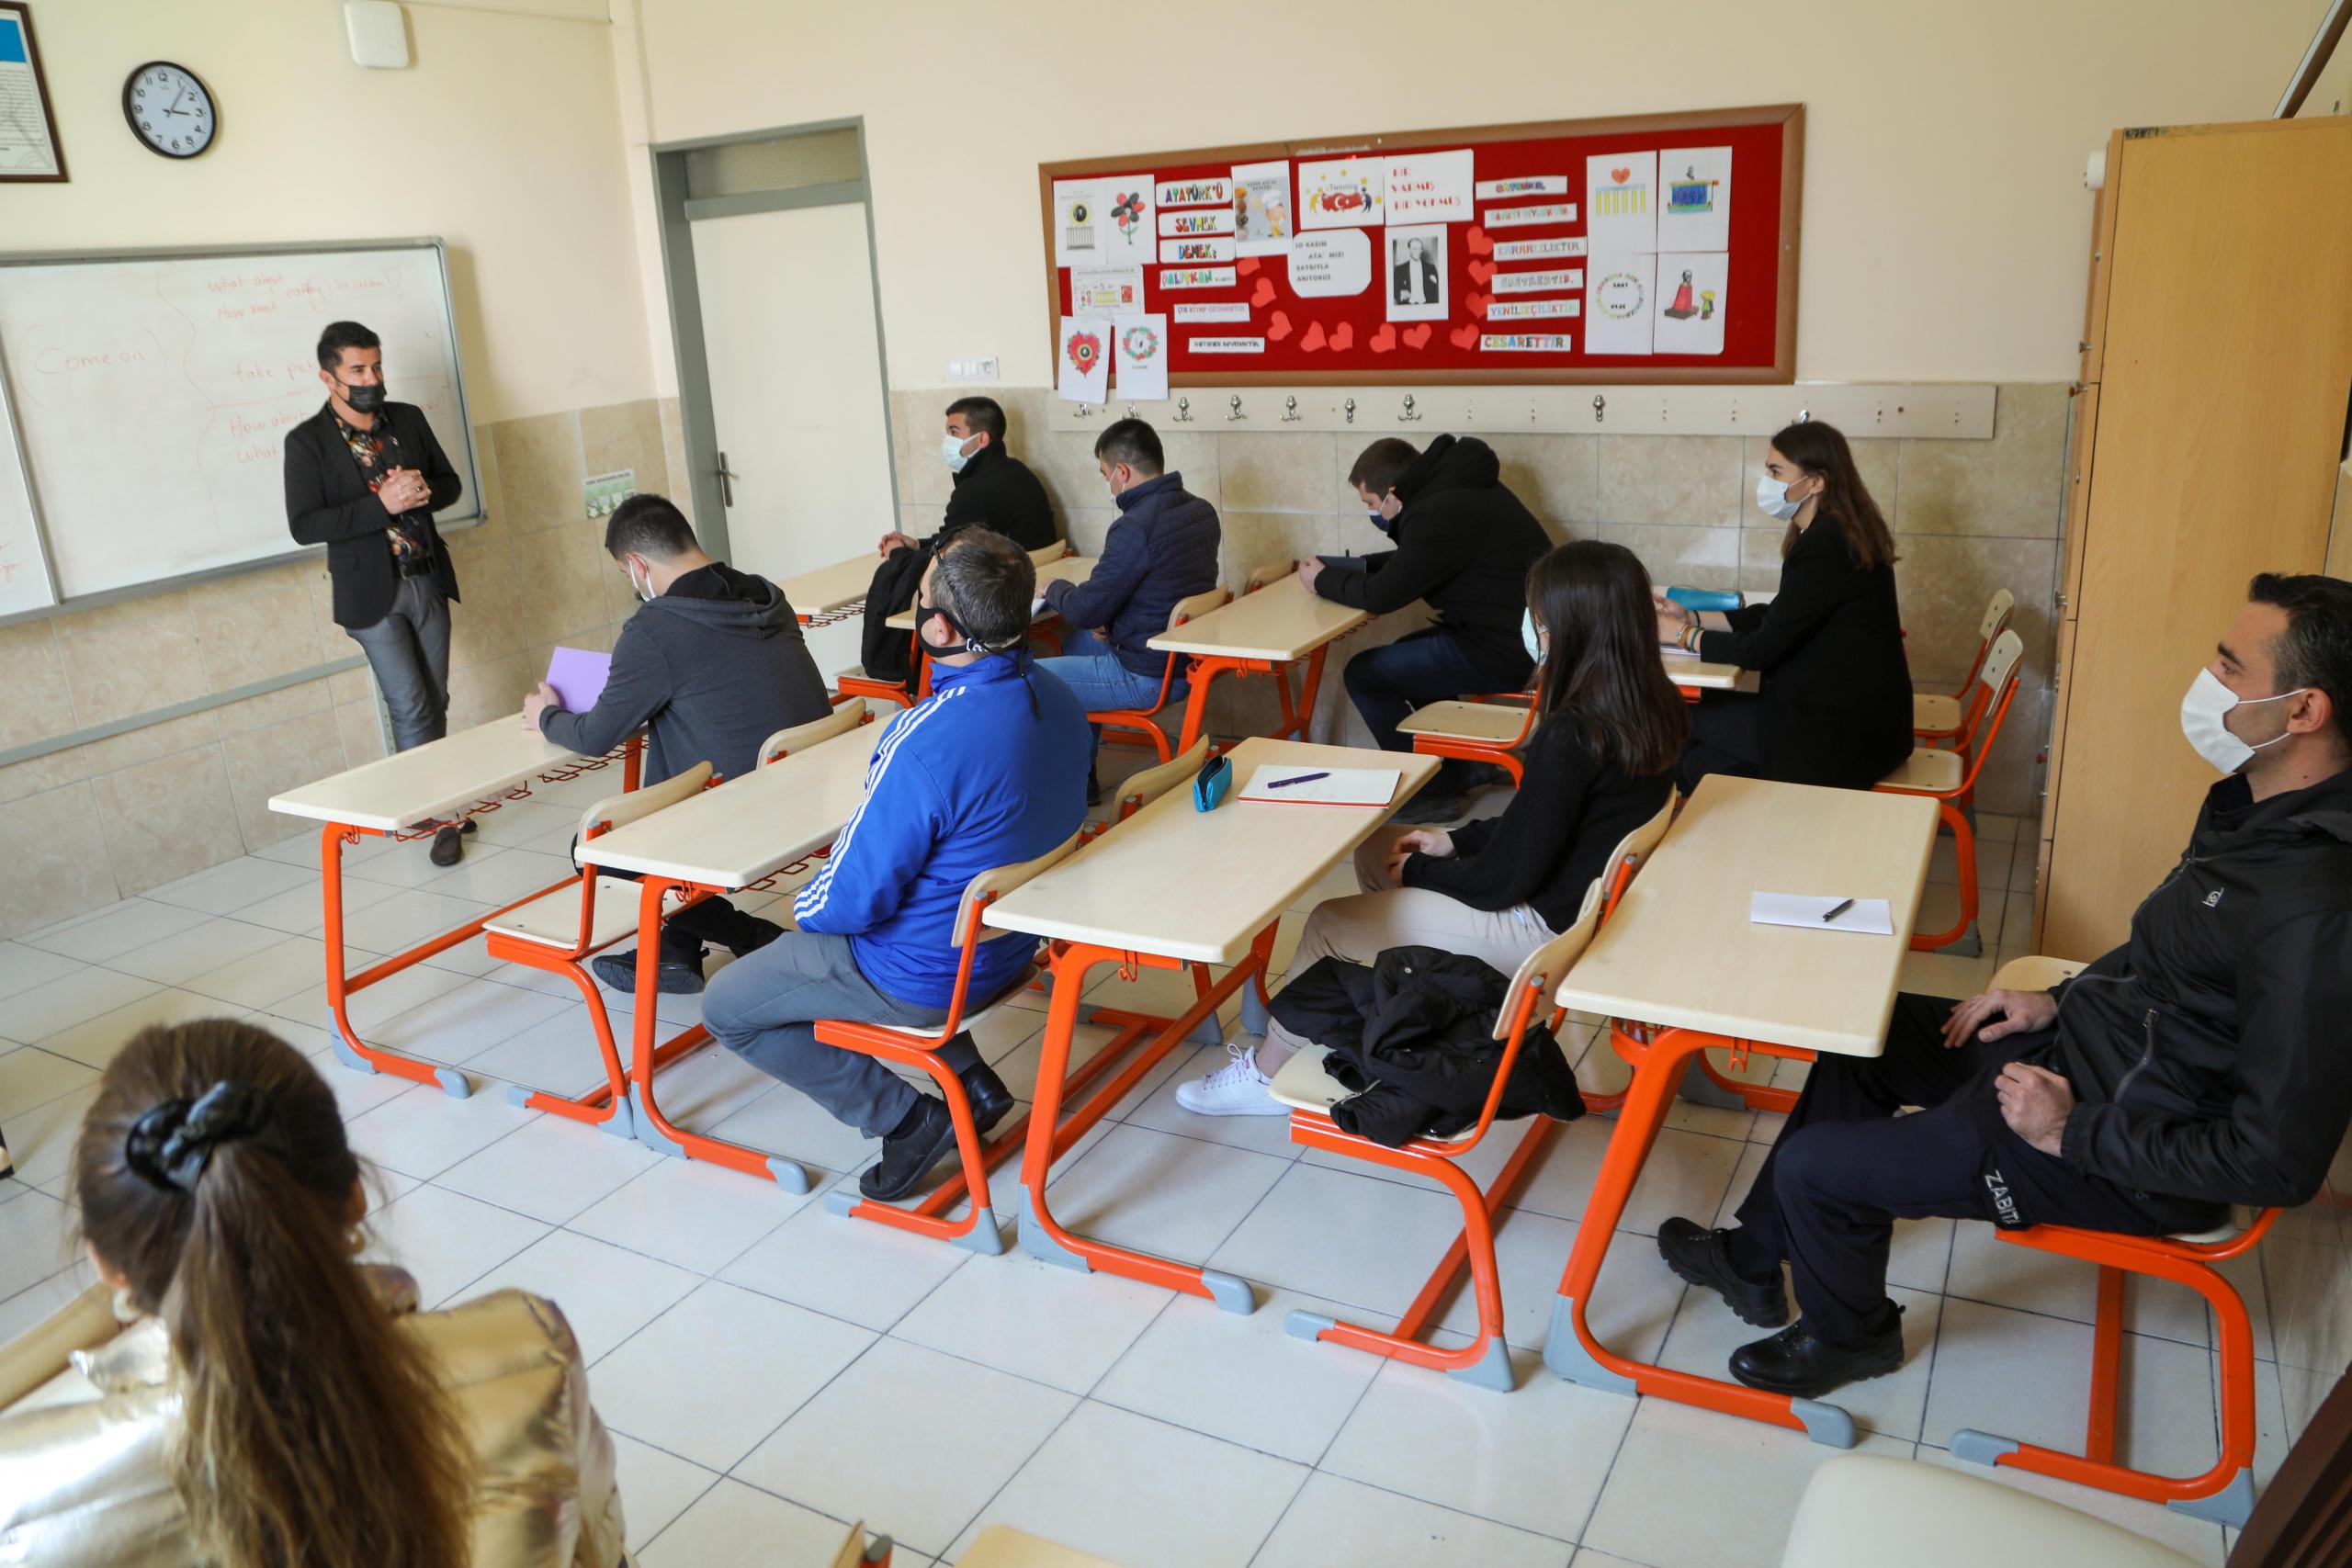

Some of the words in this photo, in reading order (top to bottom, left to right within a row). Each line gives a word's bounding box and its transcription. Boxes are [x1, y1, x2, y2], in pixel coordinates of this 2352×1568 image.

[146, 75, 153, 85] 11
[158, 73, 169, 82] 12
[176, 79, 182, 88] 1
[136, 88, 145, 98] 10
[188, 92, 196, 101] 2
[134, 104, 143, 114] 9
[195, 107, 204, 118] 3
[142, 121, 152, 130] 8
[194, 125, 202, 133] 4
[155, 134, 163, 143] 7
[186, 135, 194, 145] 5
[172, 140, 180, 149] 6
[1330, 183, 1358, 191] Twinning
[1175, 216, 1217, 232] SEVMEK
[1306, 240, 1328, 248] KASIM
[1296, 263, 1329, 271] SAYGIYLA
[1296, 274, 1331, 282] ANIYORUZ
[35, 346, 111, 375] Come
[119, 350, 145, 363] on
[230, 414, 266, 438] How
